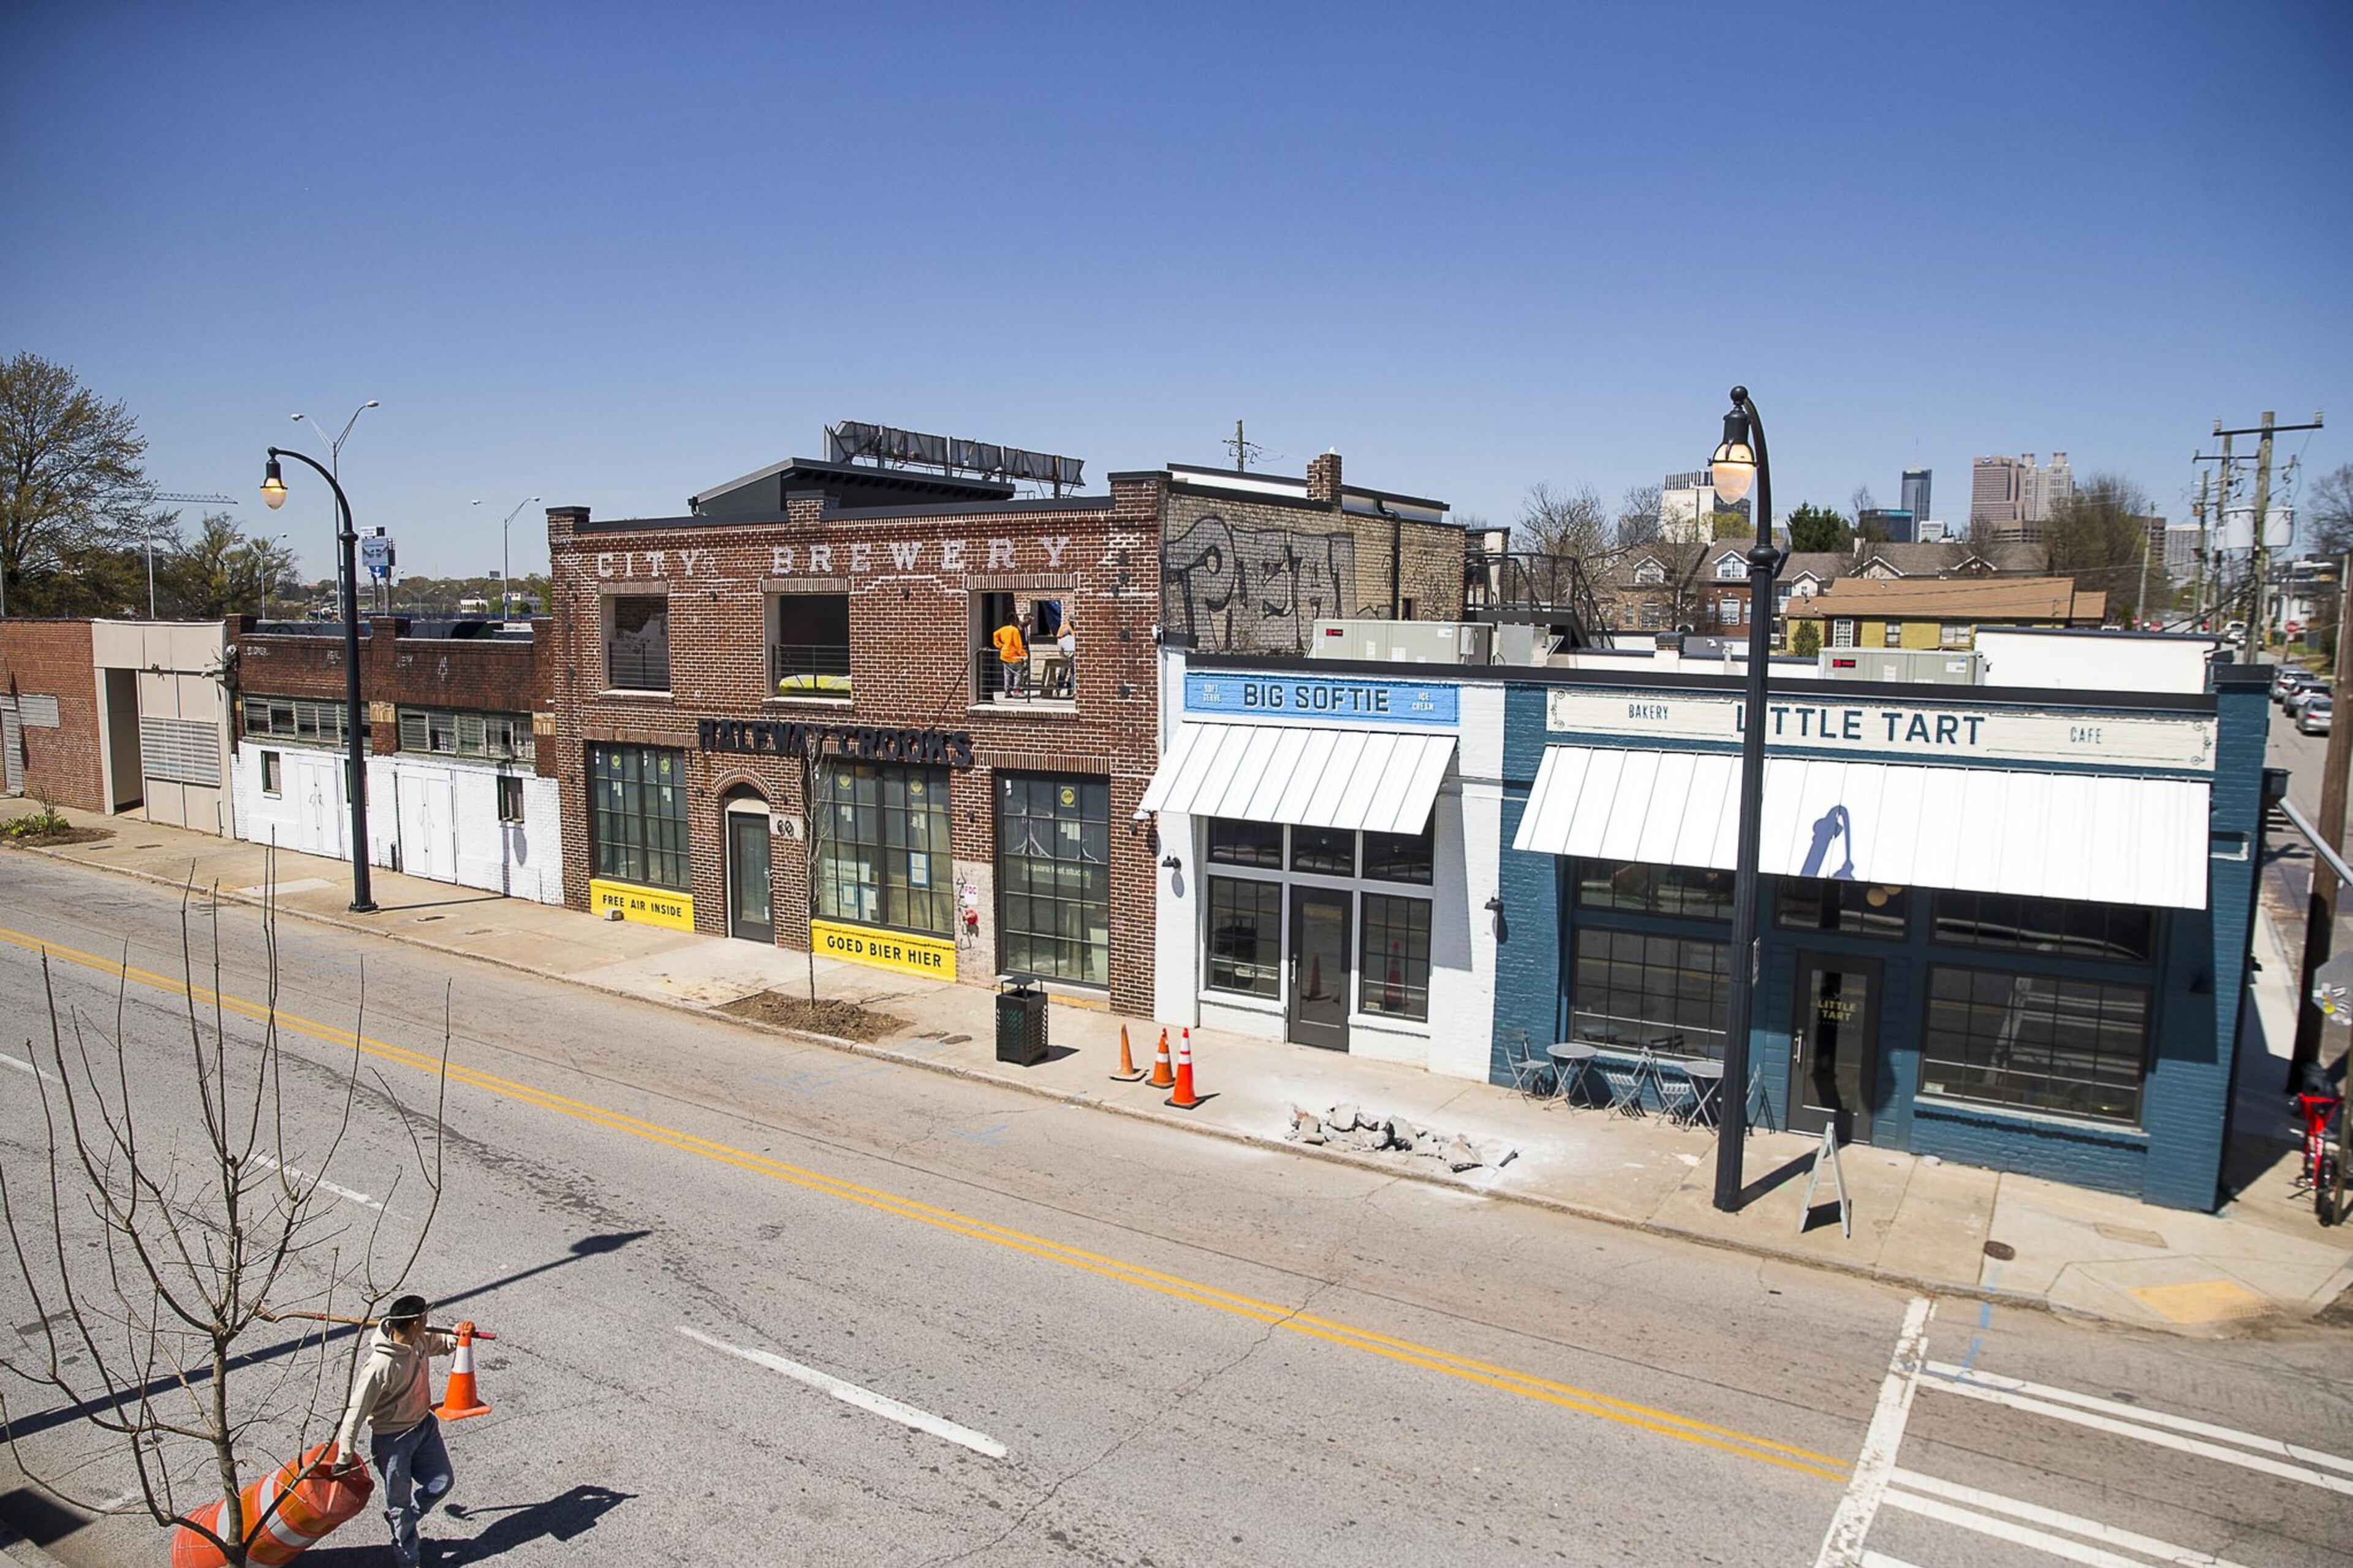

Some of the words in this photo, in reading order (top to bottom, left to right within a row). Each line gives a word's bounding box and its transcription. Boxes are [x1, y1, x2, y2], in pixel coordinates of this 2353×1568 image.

[597, 549, 700, 577] CITY
[771, 536, 1070, 574] BREWERY
[1243, 683, 1284, 709] BIG
[1295, 686, 1390, 713] SOFTIE
[1419, 692, 1430, 700] ICE
[1411, 702, 1434, 711] CREAM
[1628, 703, 1669, 721] BAKERY
[1736, 705, 1862, 740] LTTLE
[1881, 712, 1985, 745] TART
[2070, 726, 2103, 744] CAFE
[699, 719, 824, 756] HALFWAY
[839, 726, 972, 767] CROOKS
[602, 894, 625, 907] FREE
[630, 899, 646, 911] AIR
[651, 903, 682, 917] INSIDE
[827, 935, 863, 953] GOED
[870, 942, 902, 960] BIER
[908, 949, 942, 968] HIER
[1817, 1000, 1857, 1013] LITTLE
[1822, 1009, 1852, 1021] TART
